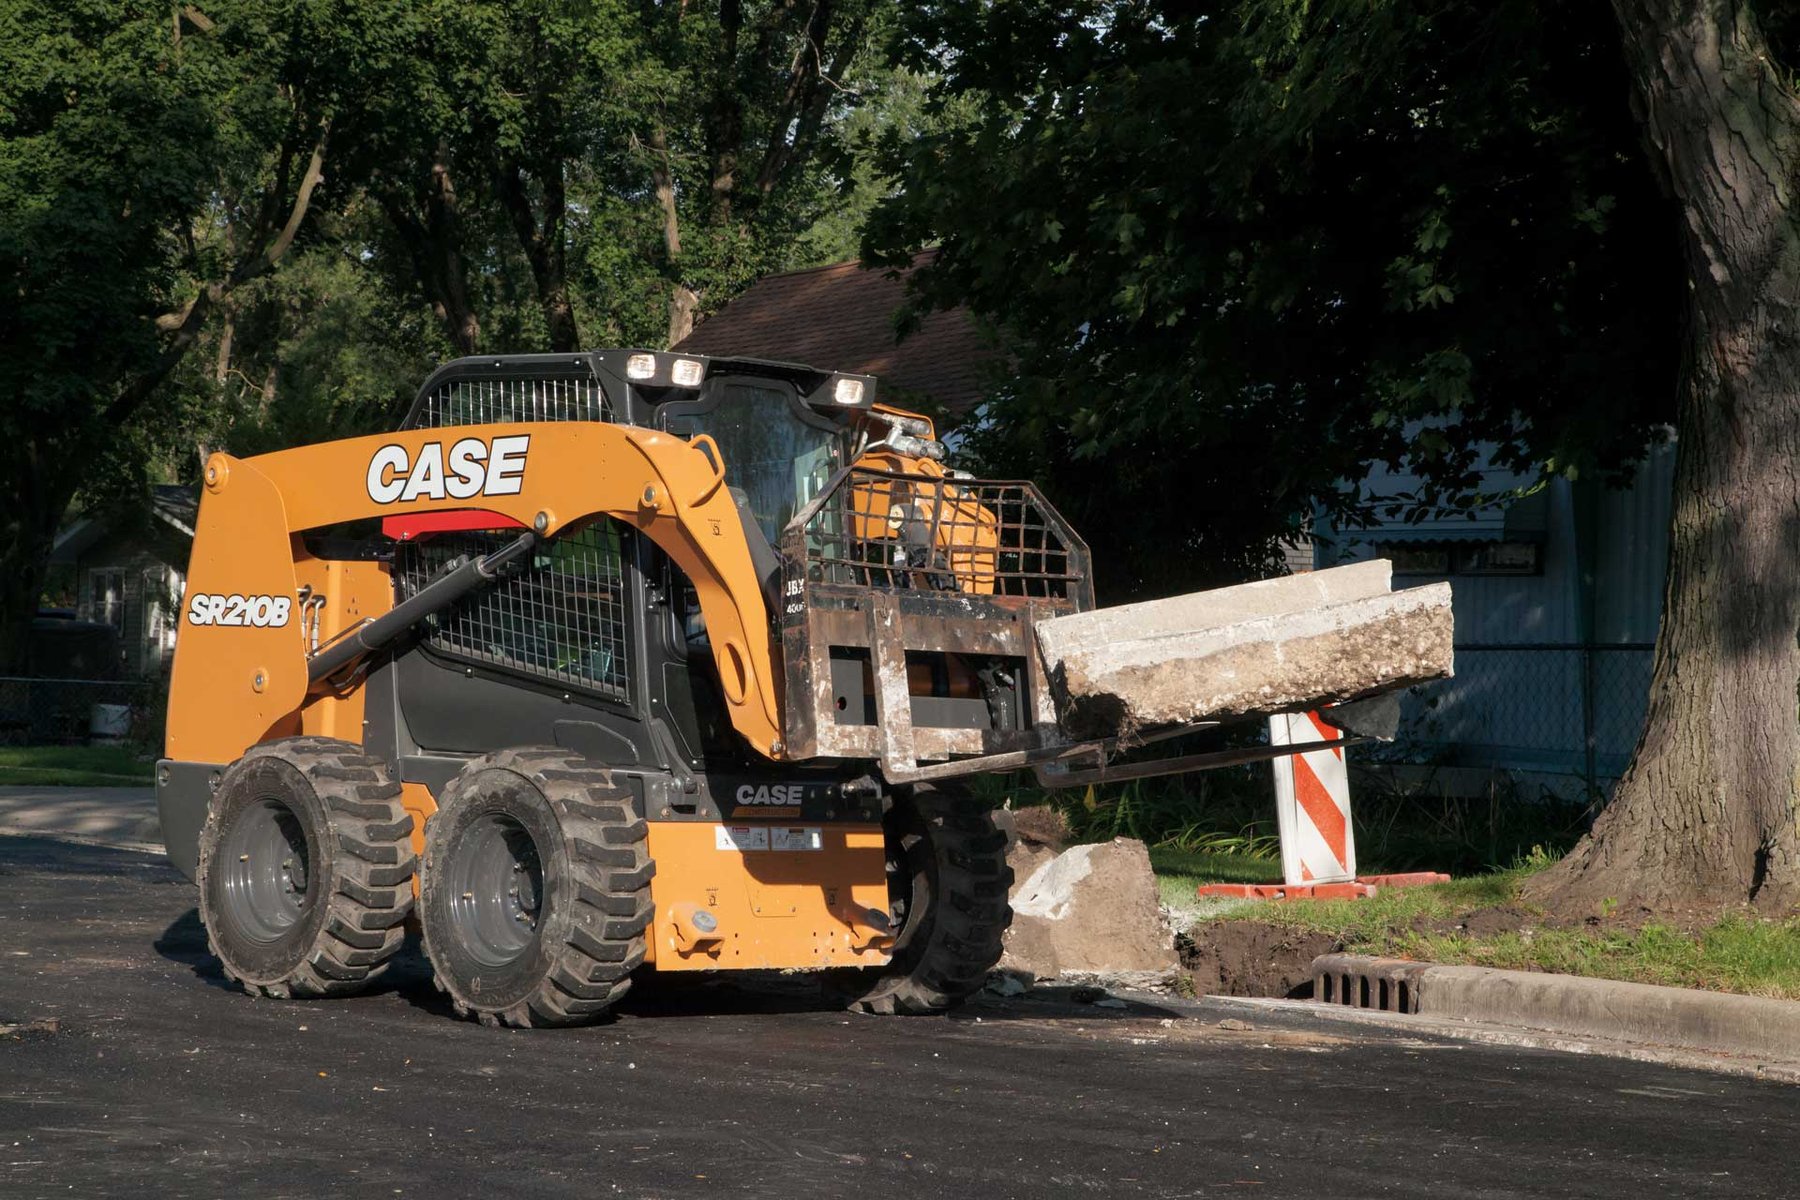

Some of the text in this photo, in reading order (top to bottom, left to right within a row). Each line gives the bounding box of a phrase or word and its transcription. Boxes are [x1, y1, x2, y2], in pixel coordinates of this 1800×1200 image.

[367, 434, 530, 503] CASE
[786, 578, 804, 596] JBX
[188, 593, 291, 627] SR210B
[736, 785, 803, 805] CASE
